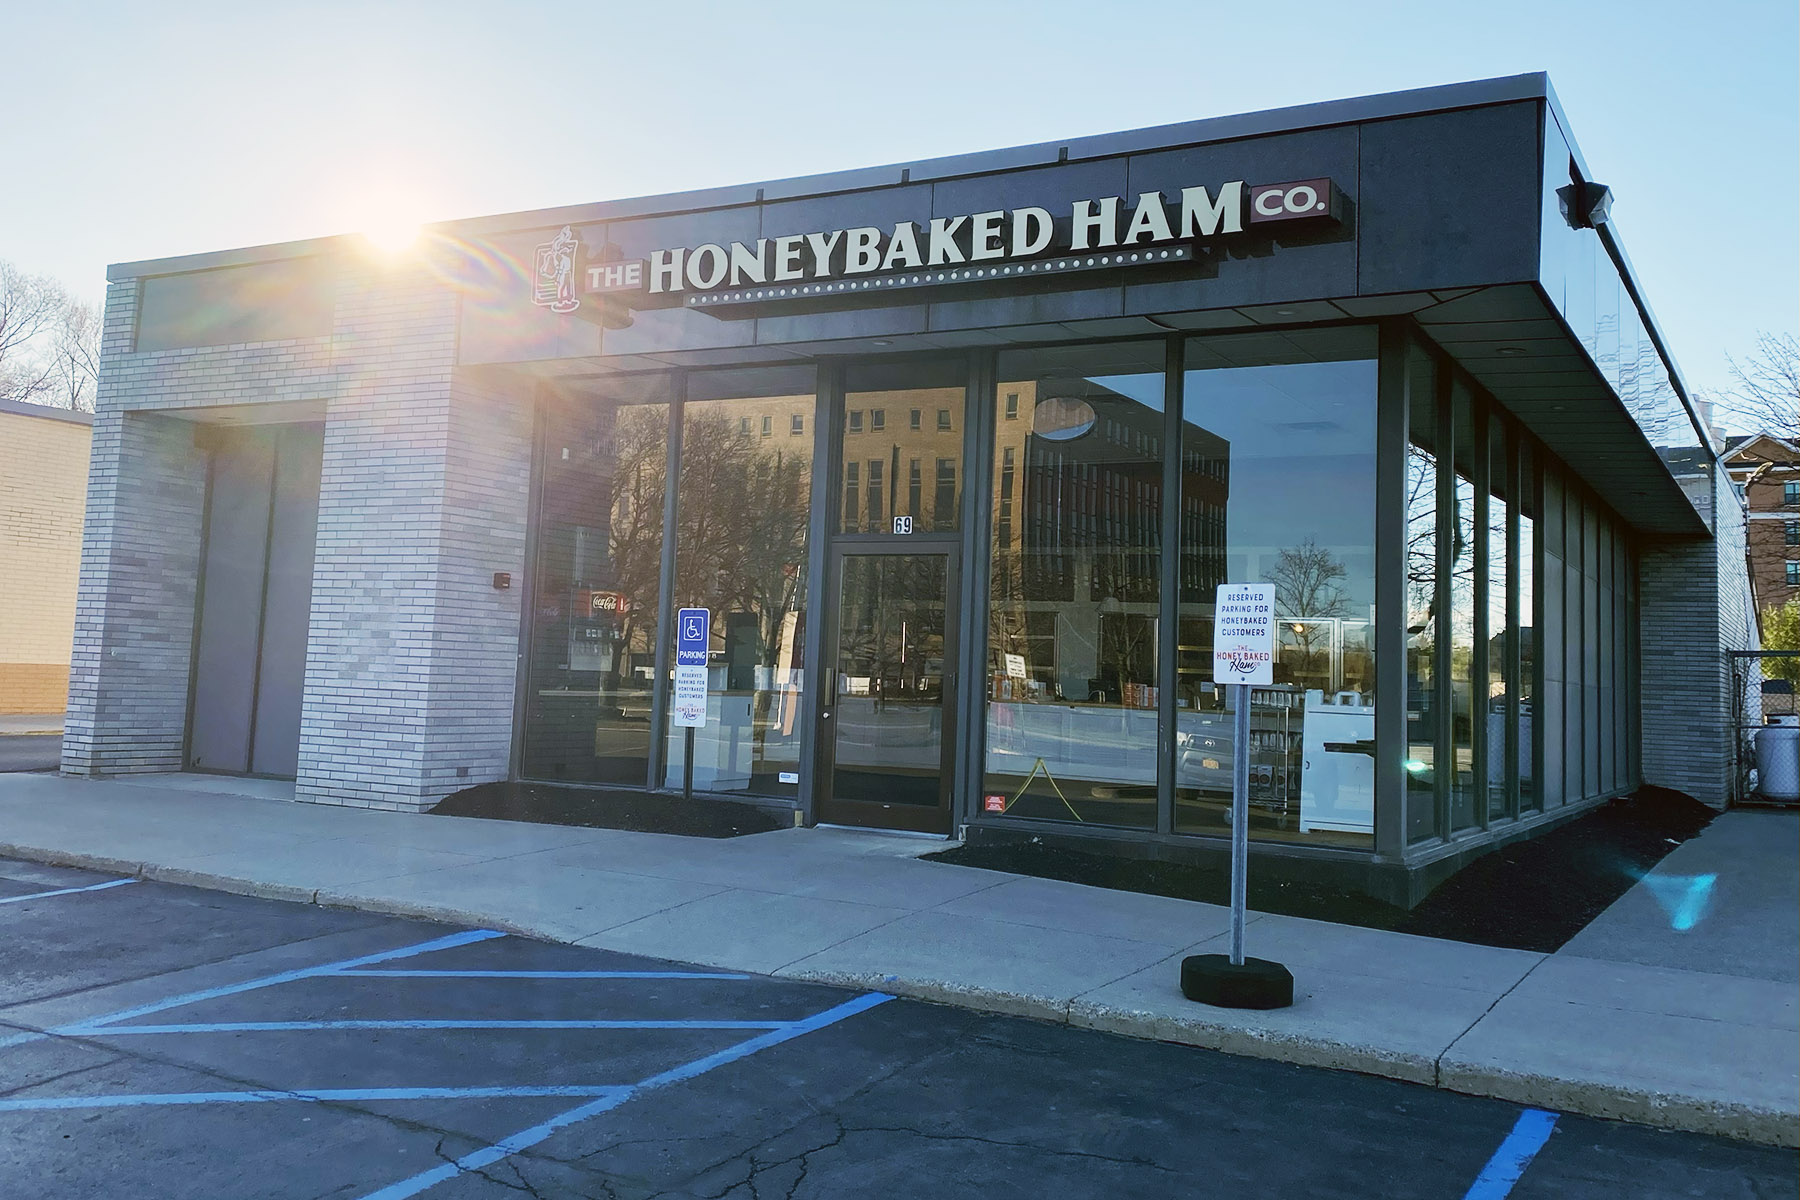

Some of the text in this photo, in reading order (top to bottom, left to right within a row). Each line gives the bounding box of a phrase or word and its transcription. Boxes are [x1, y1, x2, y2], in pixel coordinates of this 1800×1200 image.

[588, 180, 1326, 294] THE HONEYBAKED HAM CO.
[895, 517, 911, 534] 69
[1227, 593, 1264, 602] RESERVED
[1221, 605, 1269, 613] PARKING FOR
[1221, 617, 1268, 625] HONEYBAKED
[1221, 628, 1265, 637] CUSTOMERS
[679, 650, 706, 660] PARKING
[1216, 652, 1270, 661] HONEY BAKED
[1229, 659, 1257, 674] Ham
